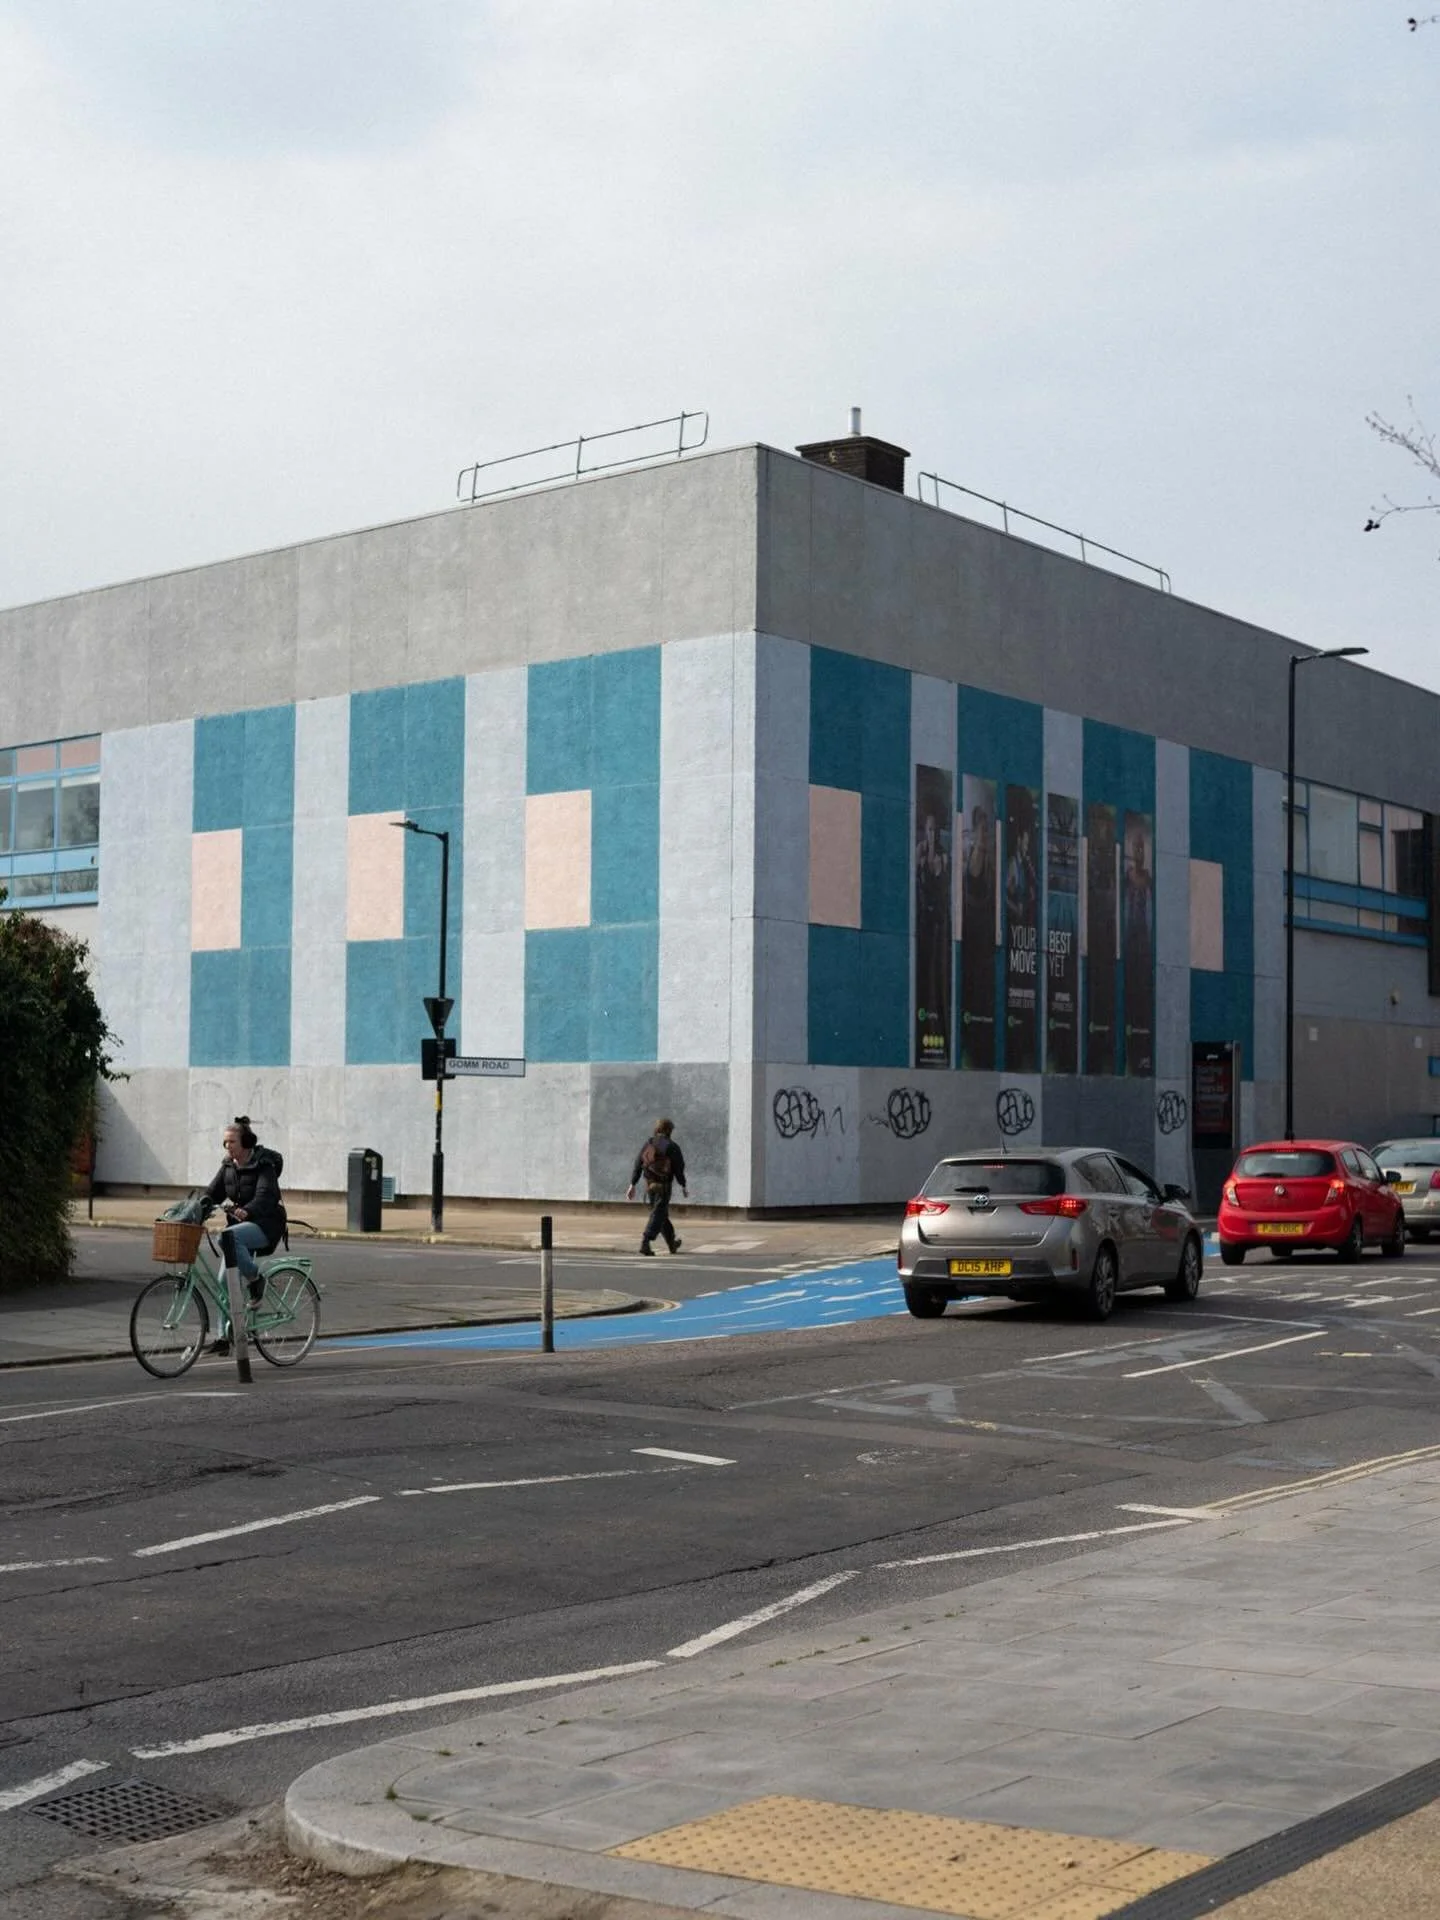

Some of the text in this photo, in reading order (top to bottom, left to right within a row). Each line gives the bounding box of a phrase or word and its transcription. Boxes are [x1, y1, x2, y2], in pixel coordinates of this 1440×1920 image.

[1010, 925, 1072, 955] YOUR BEST
[1009, 948, 1065, 977] MOVE YET
[449, 1060, 510, 1070] GOMM ROAD
